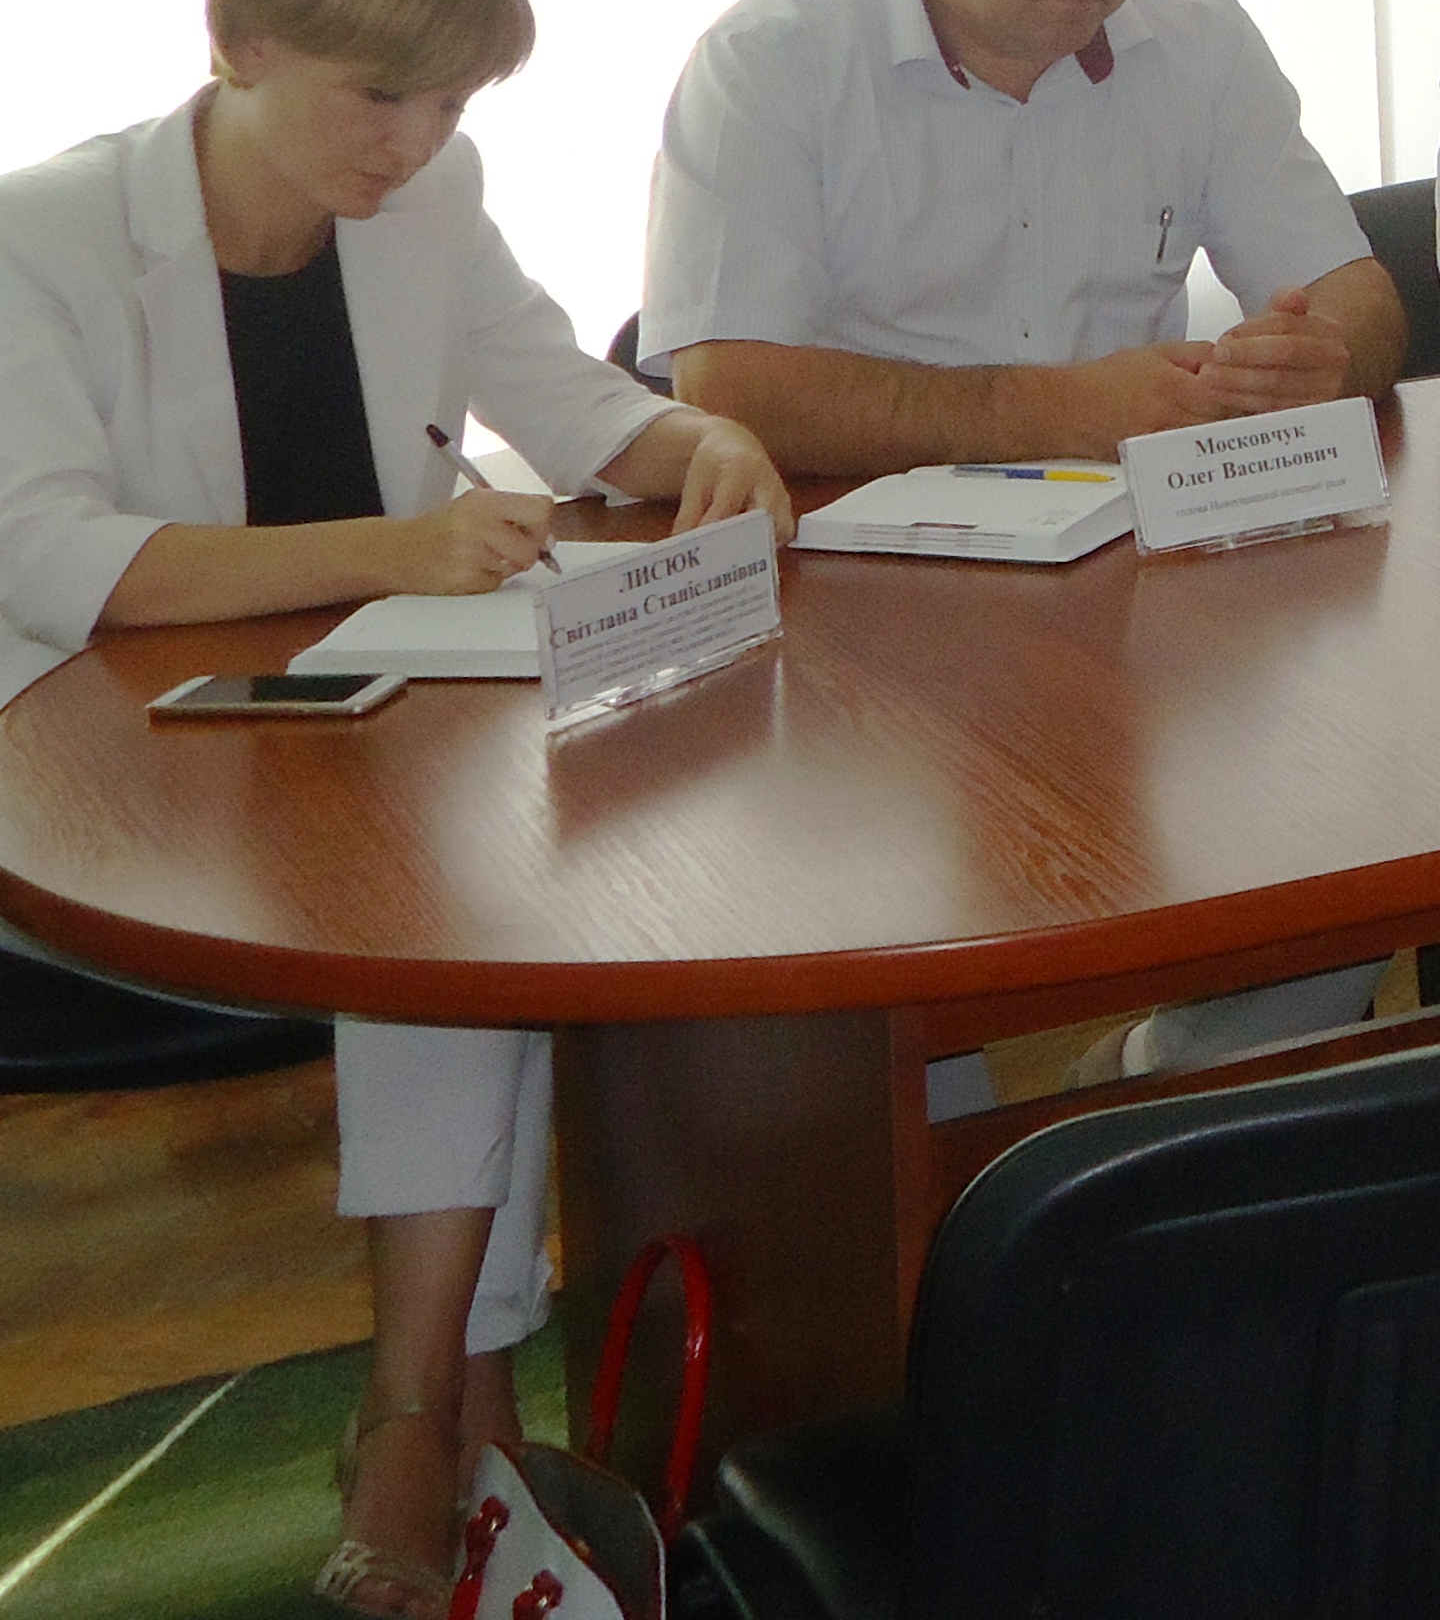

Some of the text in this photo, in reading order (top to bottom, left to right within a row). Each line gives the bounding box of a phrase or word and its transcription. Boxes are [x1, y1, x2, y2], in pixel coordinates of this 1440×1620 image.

[1196, 424, 1306, 457] Московчук
[1167, 446, 1339, 490] Олег Васильович
[619, 547, 702, 593] ЛИСЮК
[550, 606, 639, 649] Світлана
[643, 558, 768, 615] Станіславівна
